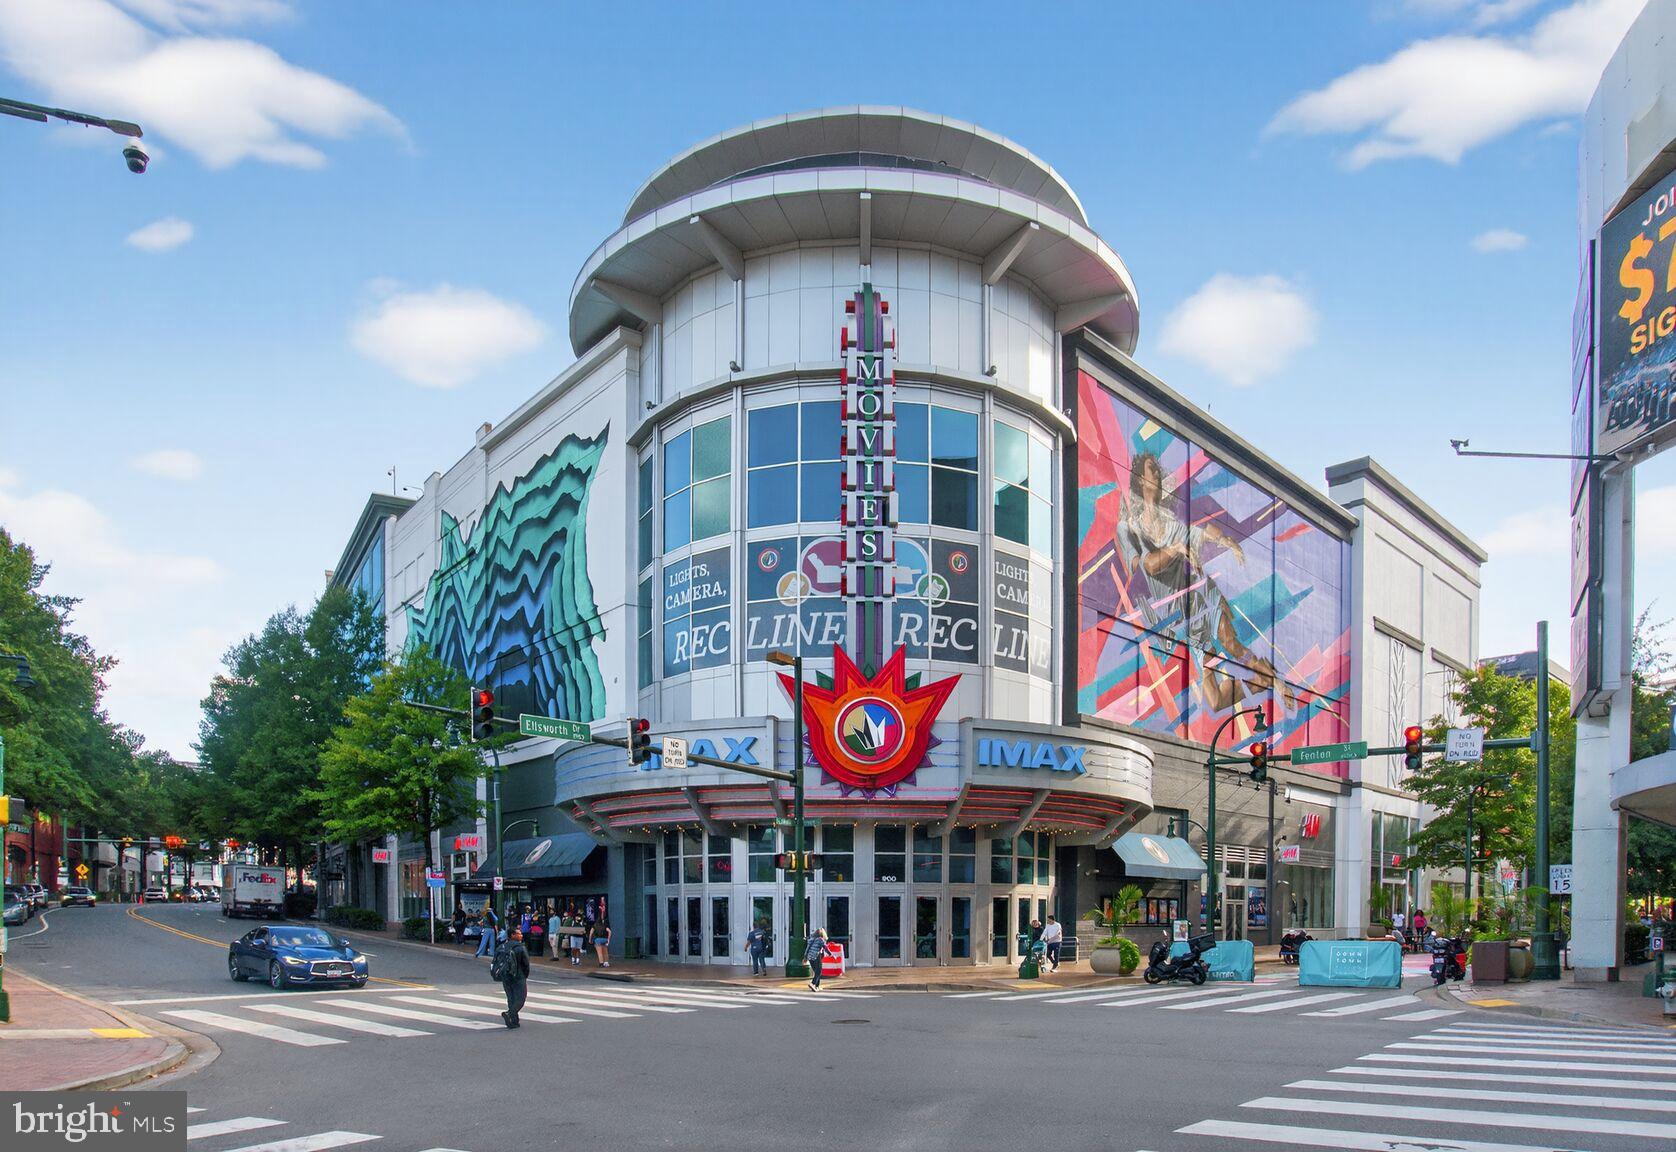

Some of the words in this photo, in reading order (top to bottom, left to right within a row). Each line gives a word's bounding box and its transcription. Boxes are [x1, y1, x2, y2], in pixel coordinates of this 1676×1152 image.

[1630, 306, 1676, 355] SIG
[857, 359, 883, 556] MOVIES
[669, 563, 710, 587] LIGHTS,
[995, 561, 1028, 582] LIGHT
[665, 581, 727, 610] CAMERA,
[672, 621, 731, 664] REC
[747, 611, 848, 649] LINE
[893, 613, 977, 650] REC
[525, 719, 568, 736] Ellsworth
[572, 724, 581, 733] Dr
[670, 740, 680, 748] NO
[978, 737, 1087, 775] IMAX
[1300, 750, 1331, 761] Fenton
[1554, 879, 1571, 891] 15
